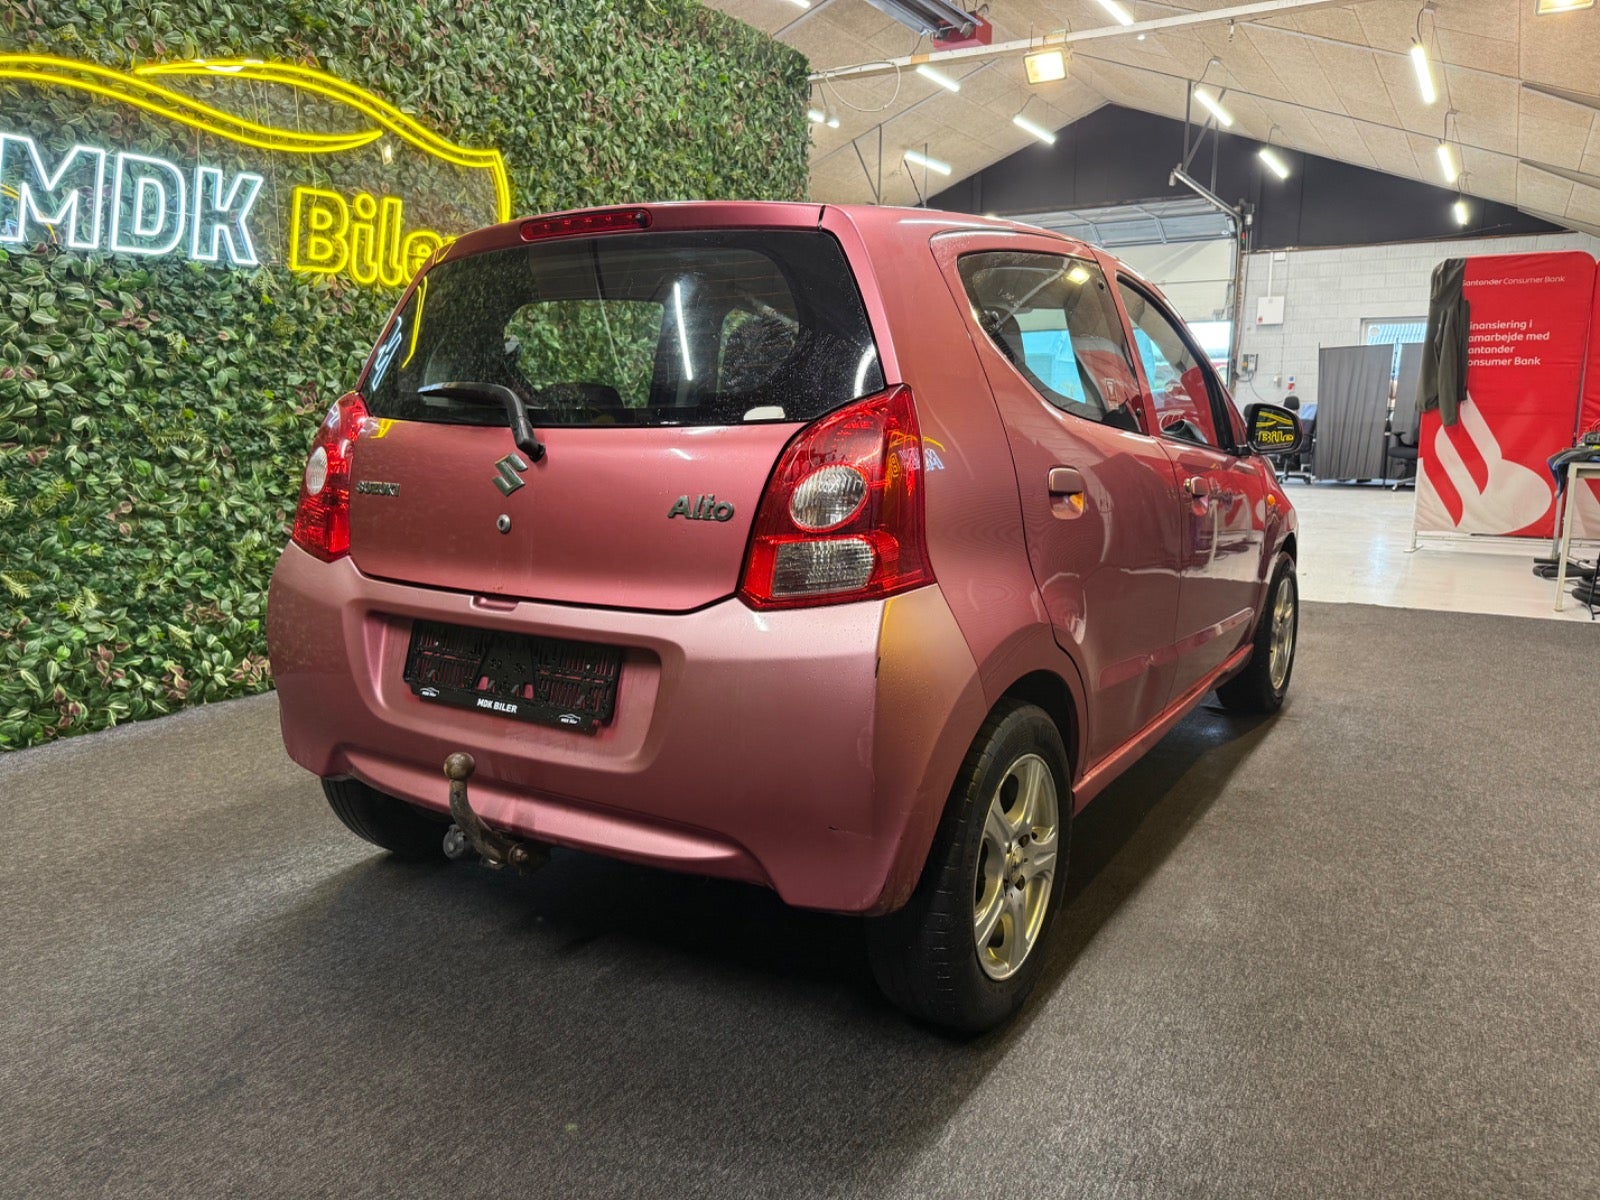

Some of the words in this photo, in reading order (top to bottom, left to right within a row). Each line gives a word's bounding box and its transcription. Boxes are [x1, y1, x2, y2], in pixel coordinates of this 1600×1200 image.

[0, 133, 263, 266] MDK
[290, 186, 454, 287] Bile
[1503, 276, 1543, 285] Consumer
[1544, 275, 1565, 284] Bank
[1469, 320, 1527, 330] inansiering
[1529, 319, 1533, 328] i
[1468, 332, 1523, 343] amarbejde
[1526, 331, 1550, 341] med
[1467, 345, 1515, 355] antander
[1467, 358, 1512, 367] onsumer
[1514, 356, 1541, 366] Bank
[356, 481, 400, 497] SUZUKI
[667, 494, 734, 522] Alto
[476, 698, 494, 709] MDK
[493, 701, 518, 713] BILER
